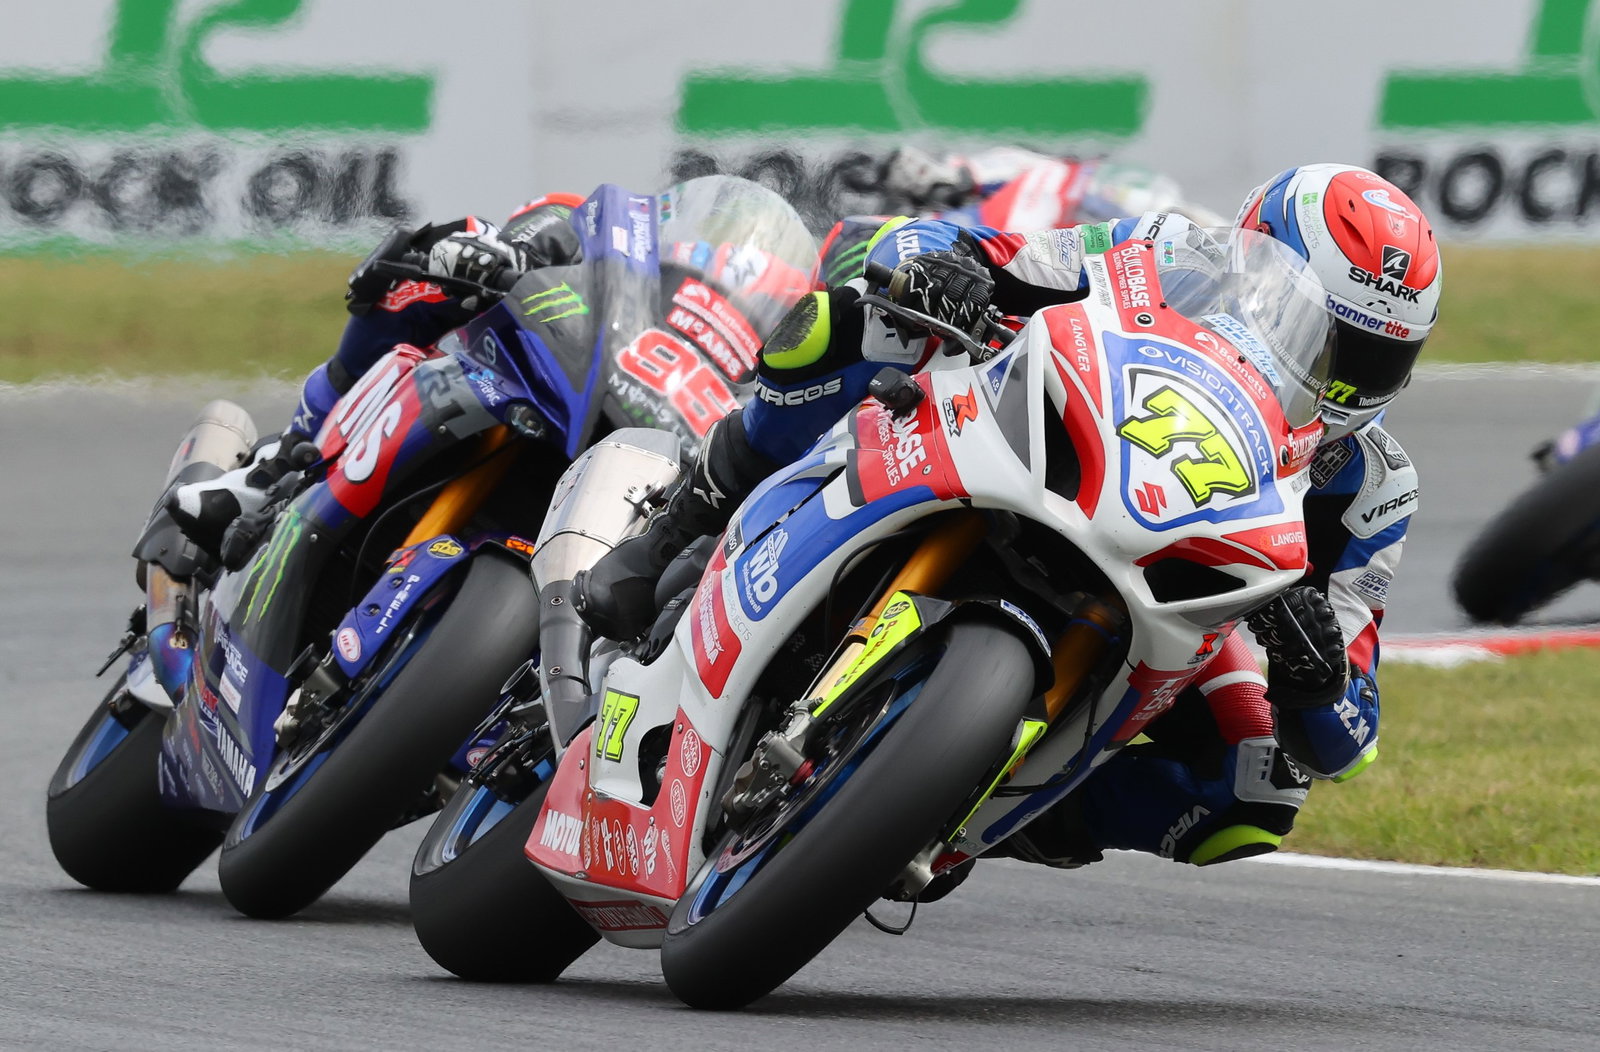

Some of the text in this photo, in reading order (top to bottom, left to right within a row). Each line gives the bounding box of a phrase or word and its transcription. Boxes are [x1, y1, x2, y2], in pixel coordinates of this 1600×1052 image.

[1120, 247, 1151, 308] BUILDBASE
[1120, 290, 1132, 309] SUPPLIES
[1348, 266, 1421, 304] SHARK
[670, 309, 742, 377] McAMS
[1219, 315, 1271, 360] POWER
[1325, 295, 1410, 340] bannertite
[1070, 318, 1091, 372] LANGVER
[753, 376, 842, 406] VIRCOS
[1219, 346, 1268, 400] Bennetts
[1325, 380, 1358, 404] 77
[942, 398, 961, 437] GSX
[1162, 350, 1271, 475] VISIONTRACK
[880, 443, 901, 487] SUPPLIES
[1116, 385, 1256, 508] 77
[429, 539, 462, 556] sbs
[376, 574, 420, 634] PIRELLI
[1364, 572, 1389, 588] POW
[845, 620, 899, 684] PIRELLI
[596, 687, 640, 763] 77
[217, 722, 257, 798] YAMAHA
[540, 809, 584, 857] MOTUL
[601, 818, 614, 871] sbs
[1160, 804, 1211, 859] VIRC
